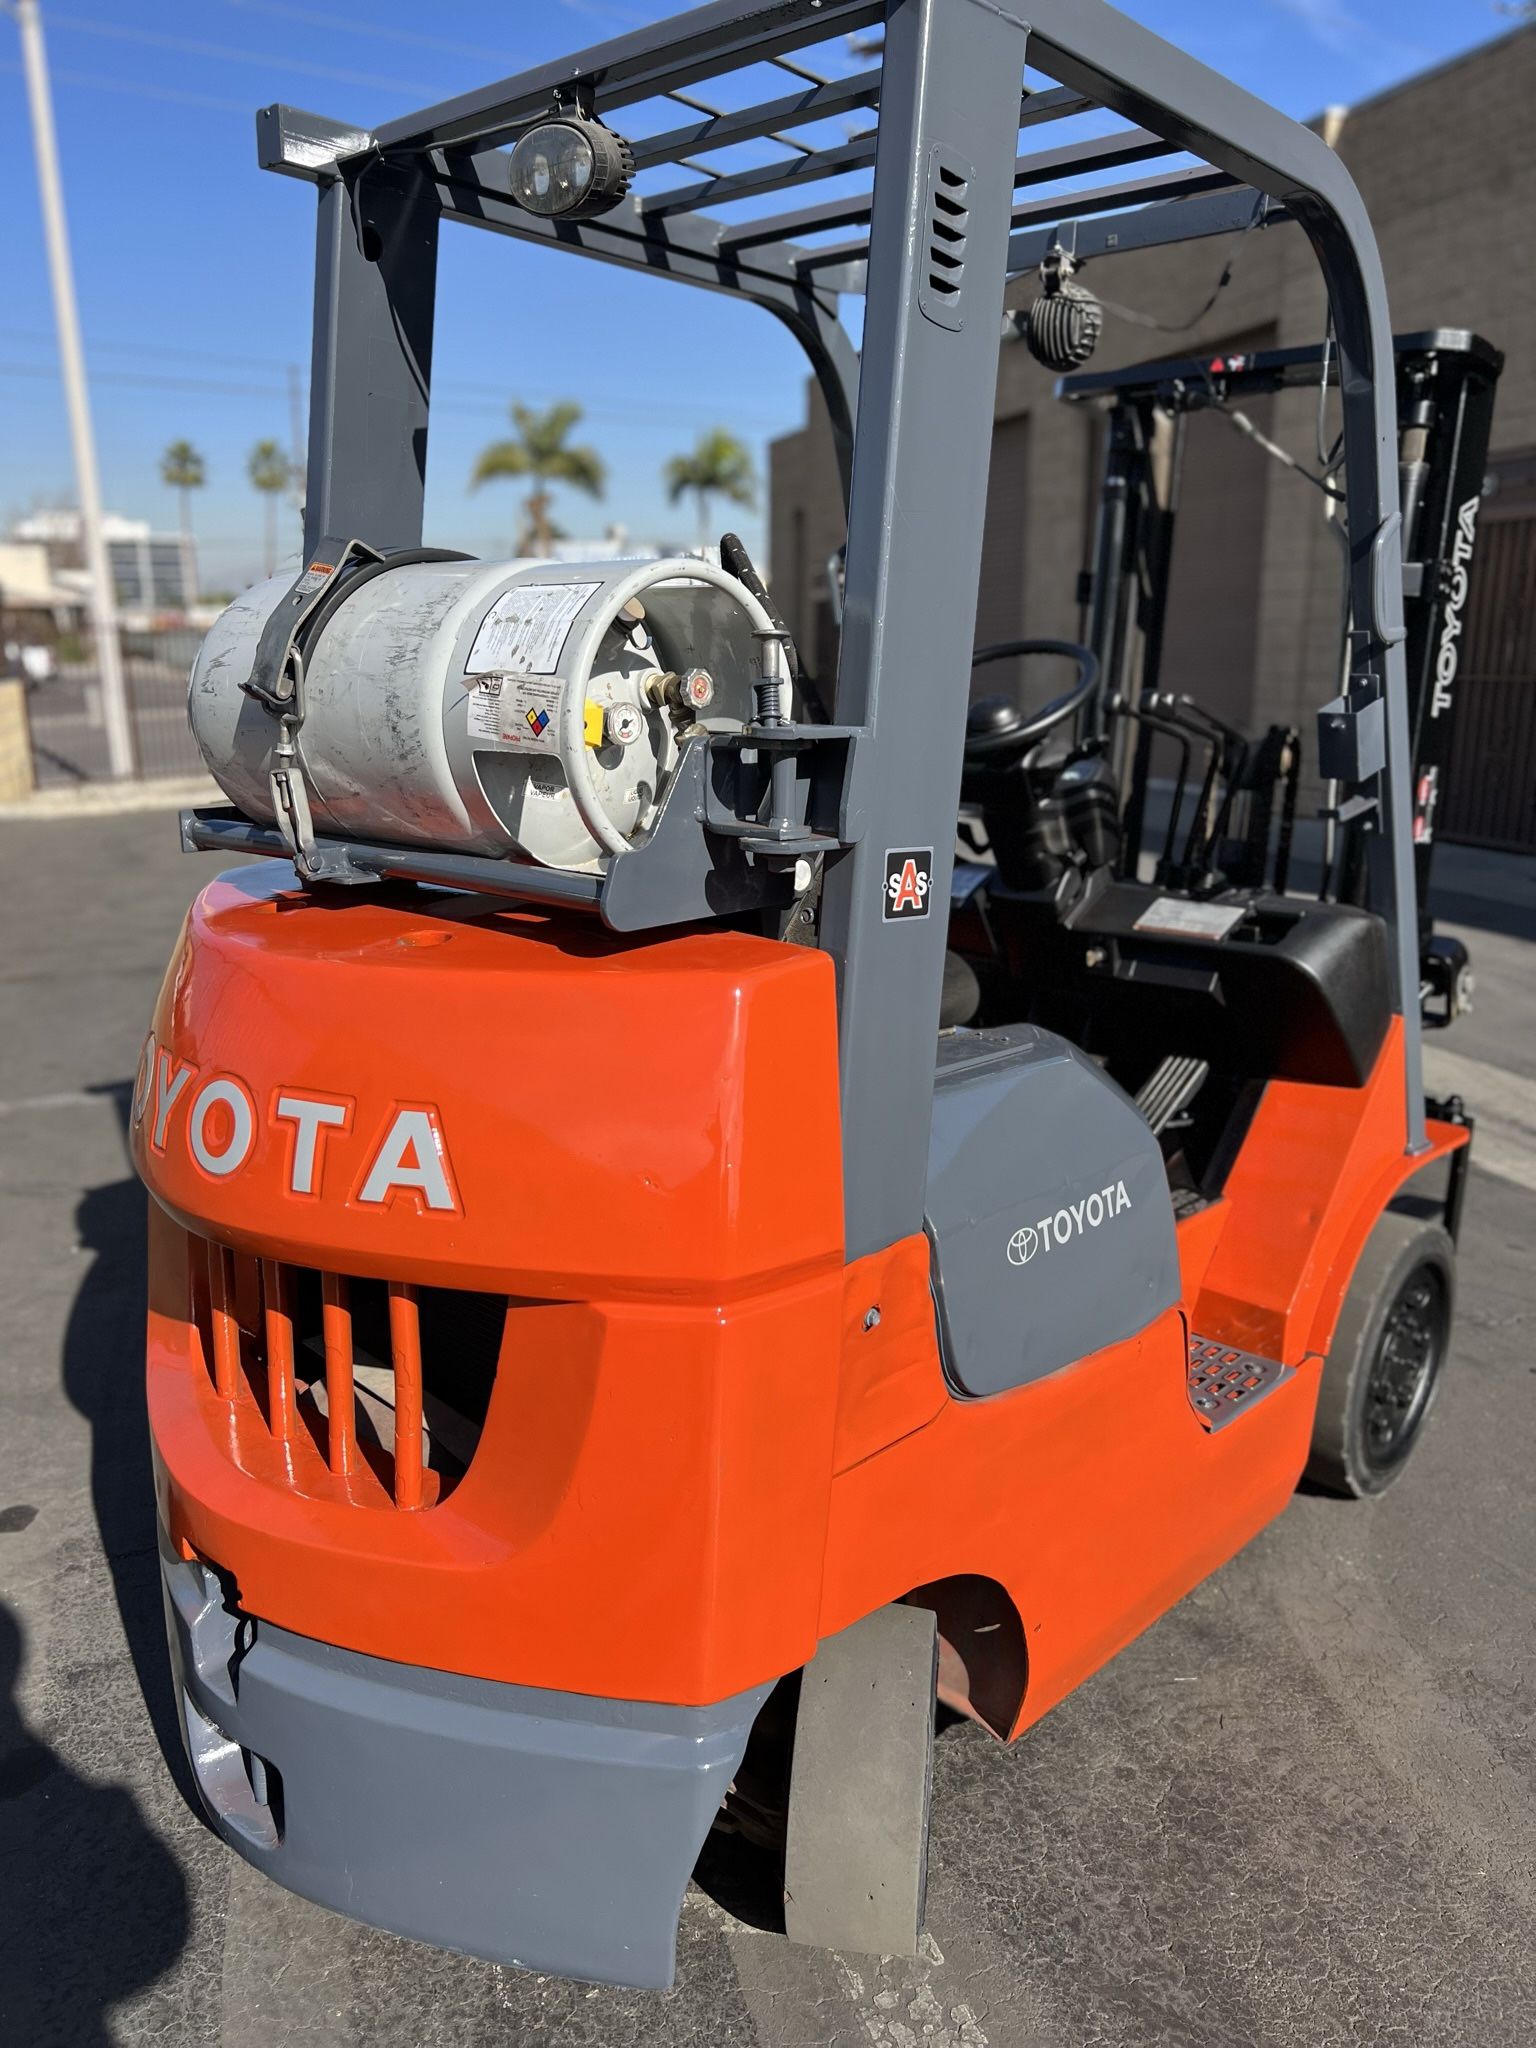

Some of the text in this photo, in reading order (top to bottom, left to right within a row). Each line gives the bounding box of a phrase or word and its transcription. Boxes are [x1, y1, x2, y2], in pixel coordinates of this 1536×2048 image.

[1430, 495, 1480, 719] TOYOTA
[888, 859, 928, 911] SAS
[134, 1032, 455, 1210] OYOTA
[1037, 1180, 1132, 1252] TOYOTA
